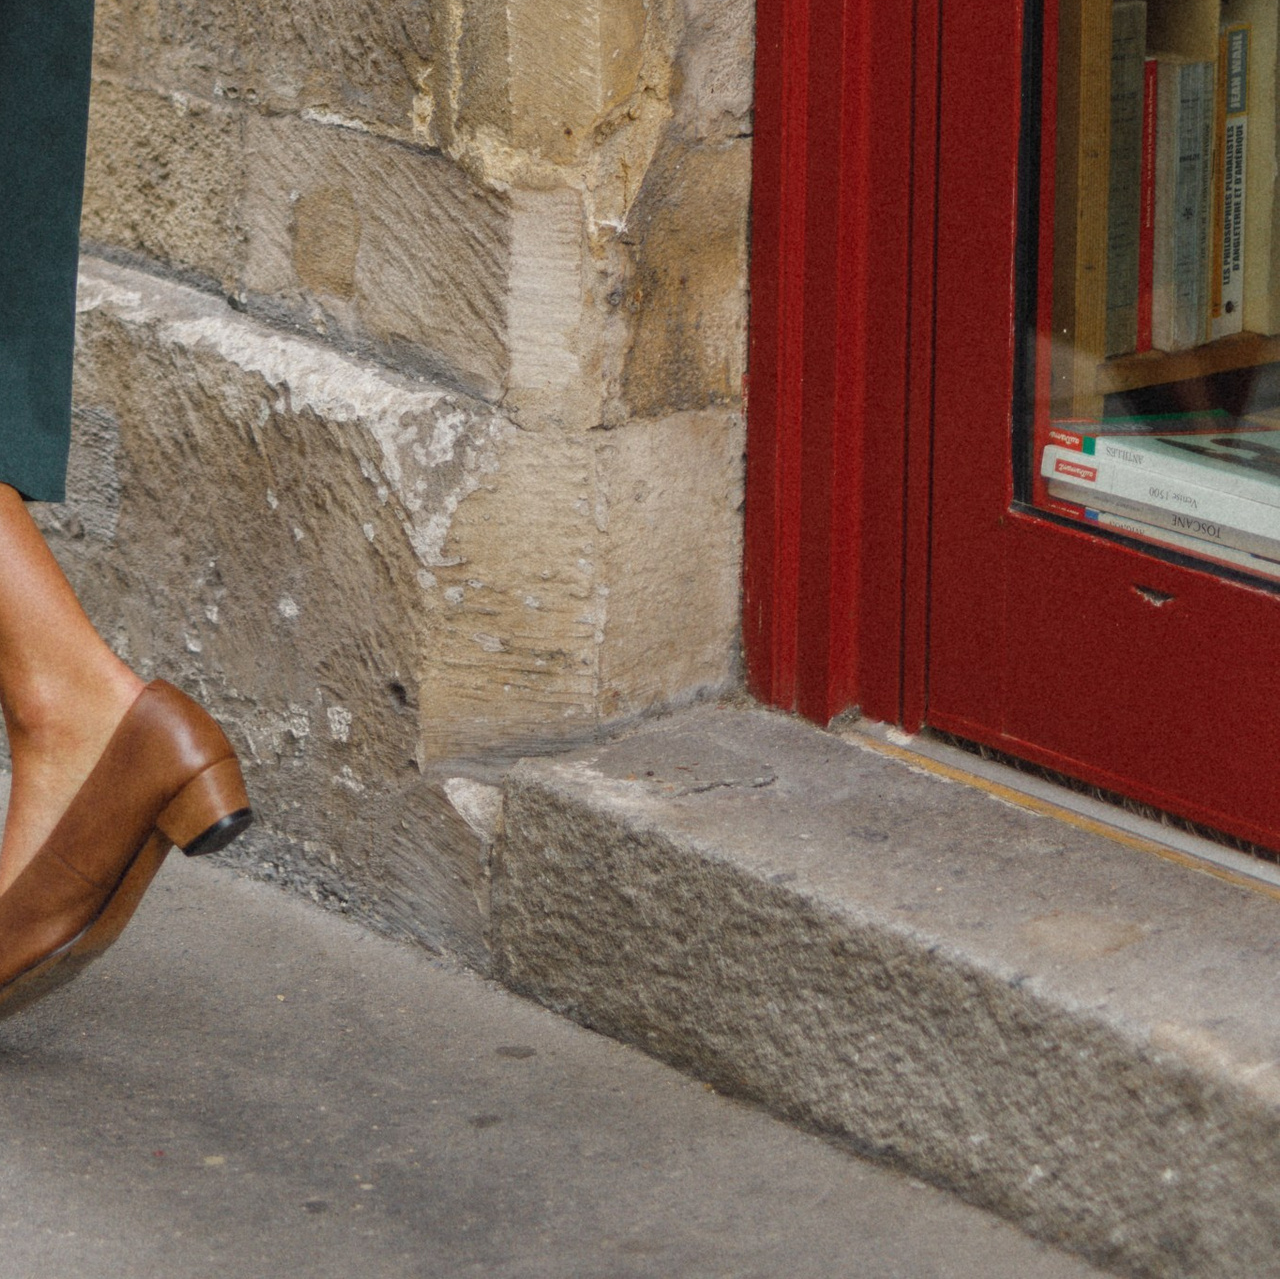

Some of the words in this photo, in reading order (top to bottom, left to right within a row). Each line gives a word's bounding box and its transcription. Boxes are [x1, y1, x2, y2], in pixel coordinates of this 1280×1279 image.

[1230, 33, 1244, 74] WAHL
[1229, 76, 1242, 109] JEAN
[1225, 125, 1235, 192] PLURALISTES
[1233, 125, 1244, 185] D'AMÉRIQUE
[1233, 186, 1242, 198] ET
[1223, 193, 1233, 266] PHILOSOPHIES
[1232, 200, 1242, 271] D'ANGLETERRE
[1222, 266, 1231, 285] LES
[1106, 447, 1144, 465] ANTILLES
[1149, 486, 1169, 501] 1500
[1172, 491, 1198, 509] Venise
[1171, 514, 1222, 539] TOSCANE
